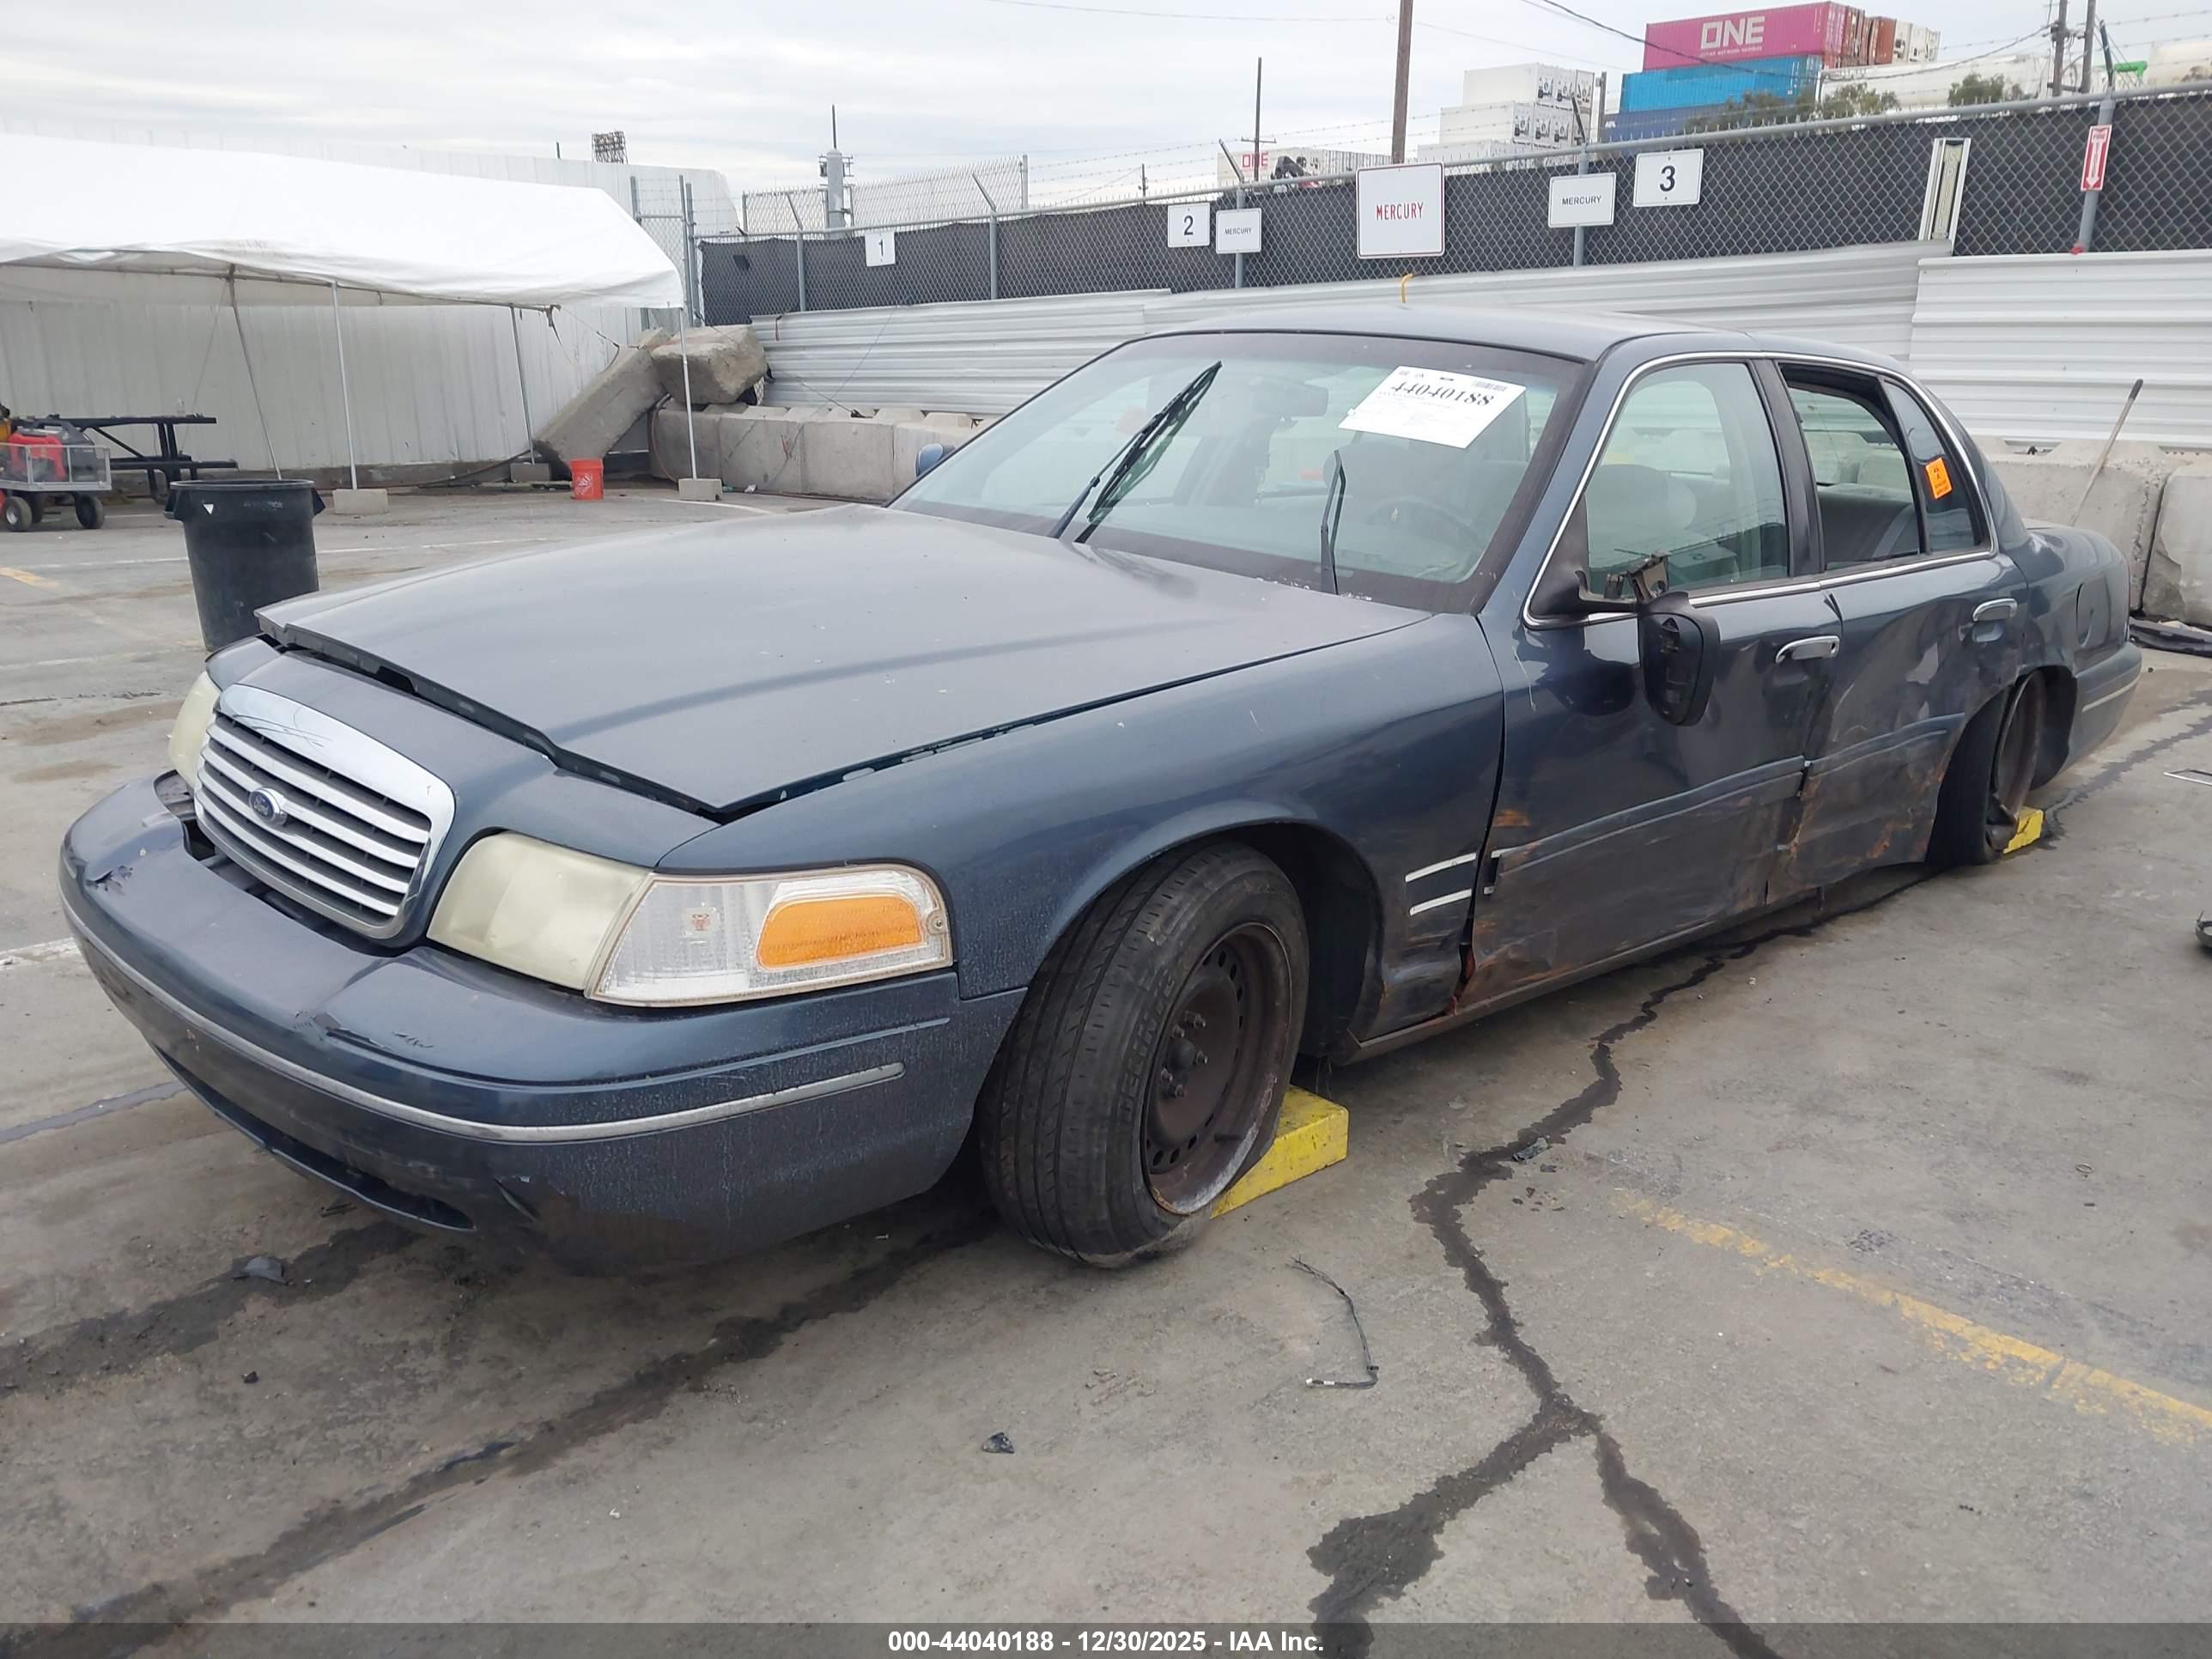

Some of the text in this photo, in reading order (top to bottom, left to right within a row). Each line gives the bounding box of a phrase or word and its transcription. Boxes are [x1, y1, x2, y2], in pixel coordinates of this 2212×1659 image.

[1700, 15, 1765, 50] ONE
[1660, 166, 1676, 191] 3
[1561, 195, 1602, 206] MERCURY
[1376, 202, 1424, 220] MERCURY
[1183, 215, 1194, 235] 2
[878, 239, 884, 257] 1
[1391, 381, 1494, 405] 44040188
